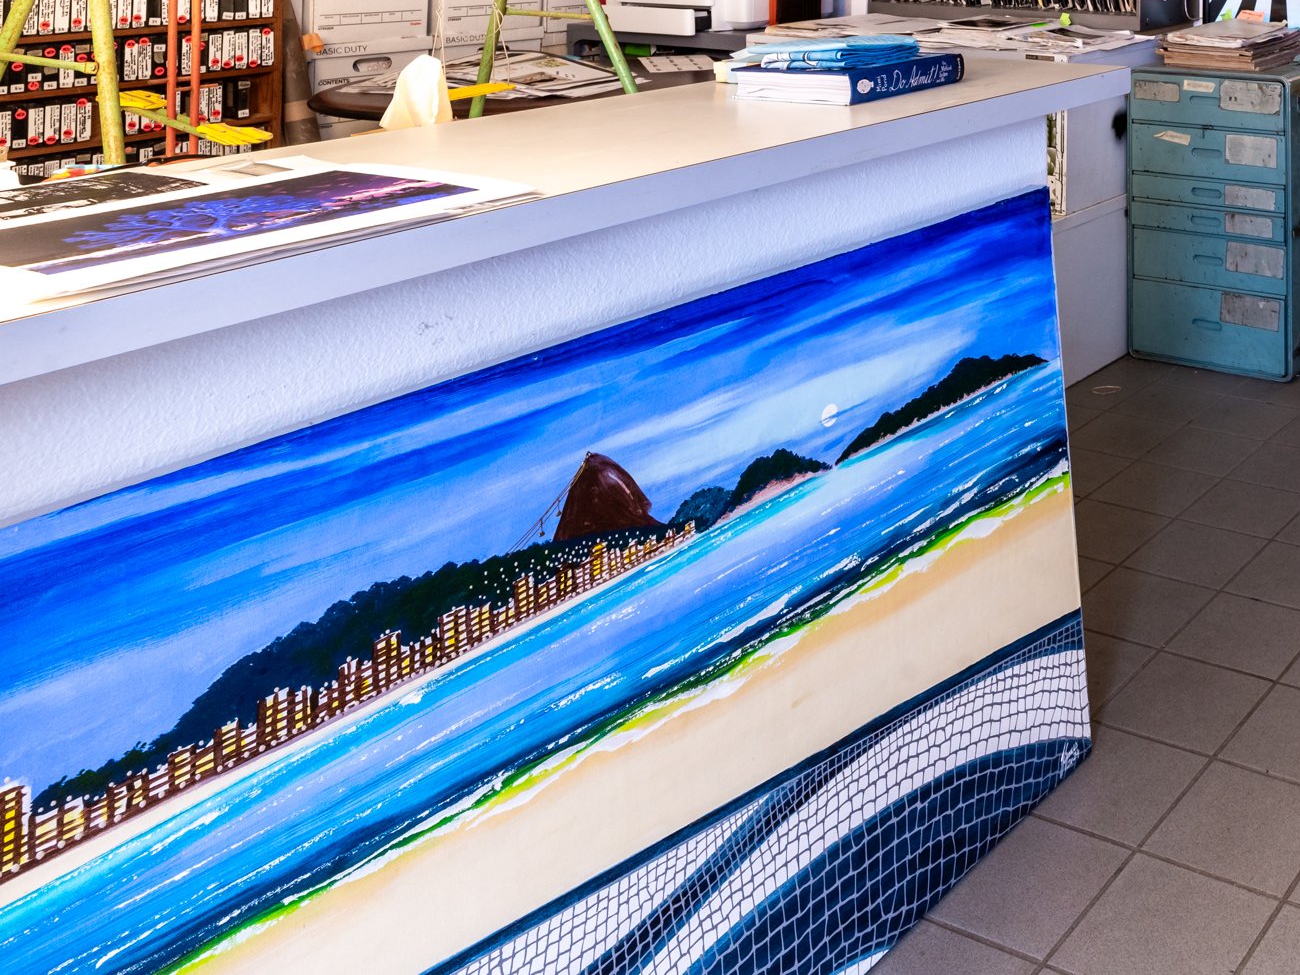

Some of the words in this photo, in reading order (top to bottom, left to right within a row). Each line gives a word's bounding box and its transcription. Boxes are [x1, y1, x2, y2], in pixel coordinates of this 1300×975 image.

[445, 35, 468, 44] BASIC
[344, 45, 368, 54] DUTY
[889, 69, 907, 92] Do
[905, 63, 939, 88] Admit!
